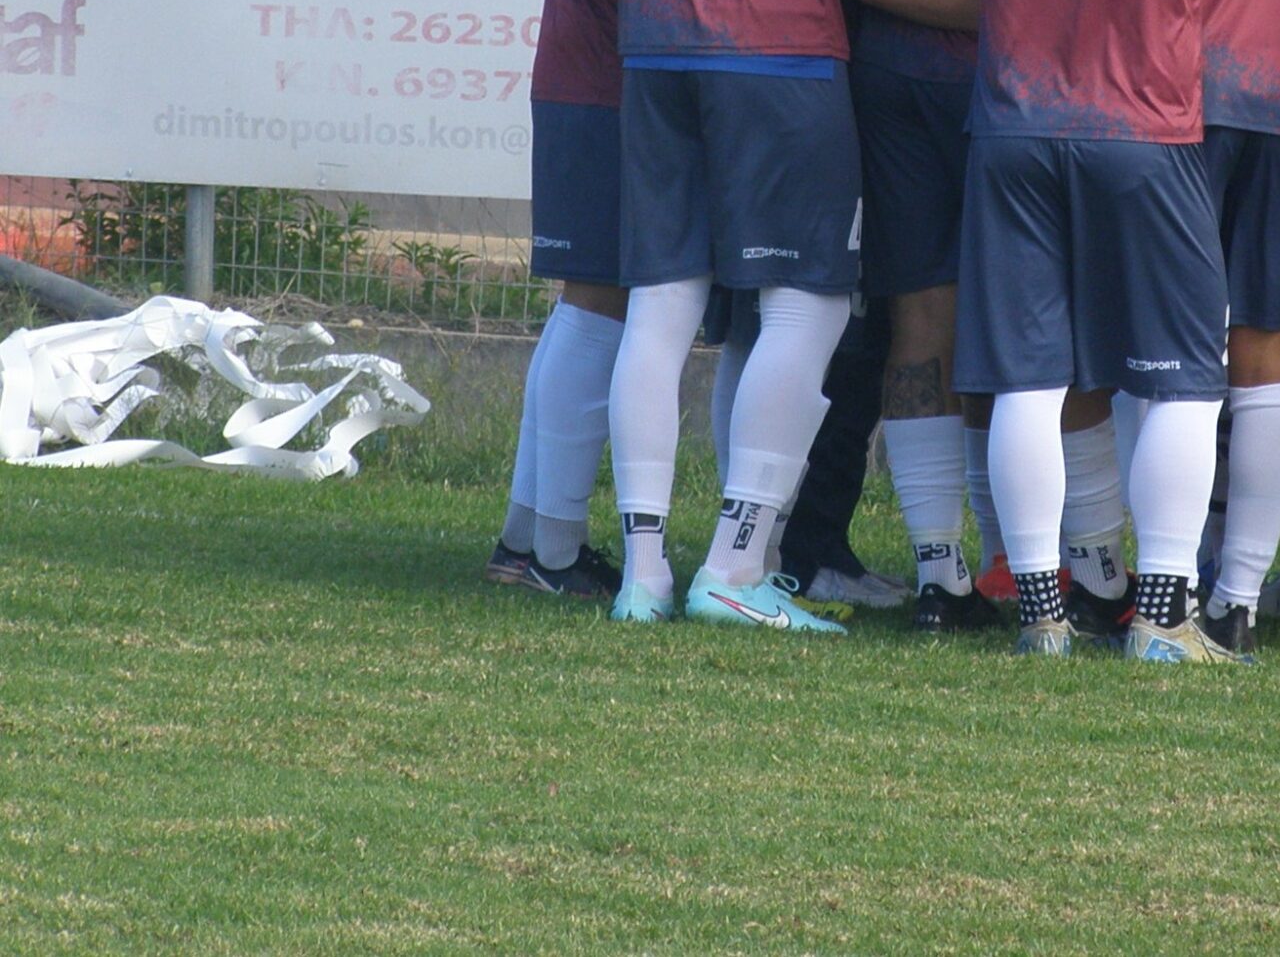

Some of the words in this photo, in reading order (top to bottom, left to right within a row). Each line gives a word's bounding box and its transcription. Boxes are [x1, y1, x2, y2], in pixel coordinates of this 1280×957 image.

[249, 3, 375, 42] ΤΗΛ:
[389, 10, 542, 49] 26230
[274, 60, 379, 97] ΚΝ.
[393, 66, 535, 102] 6937
